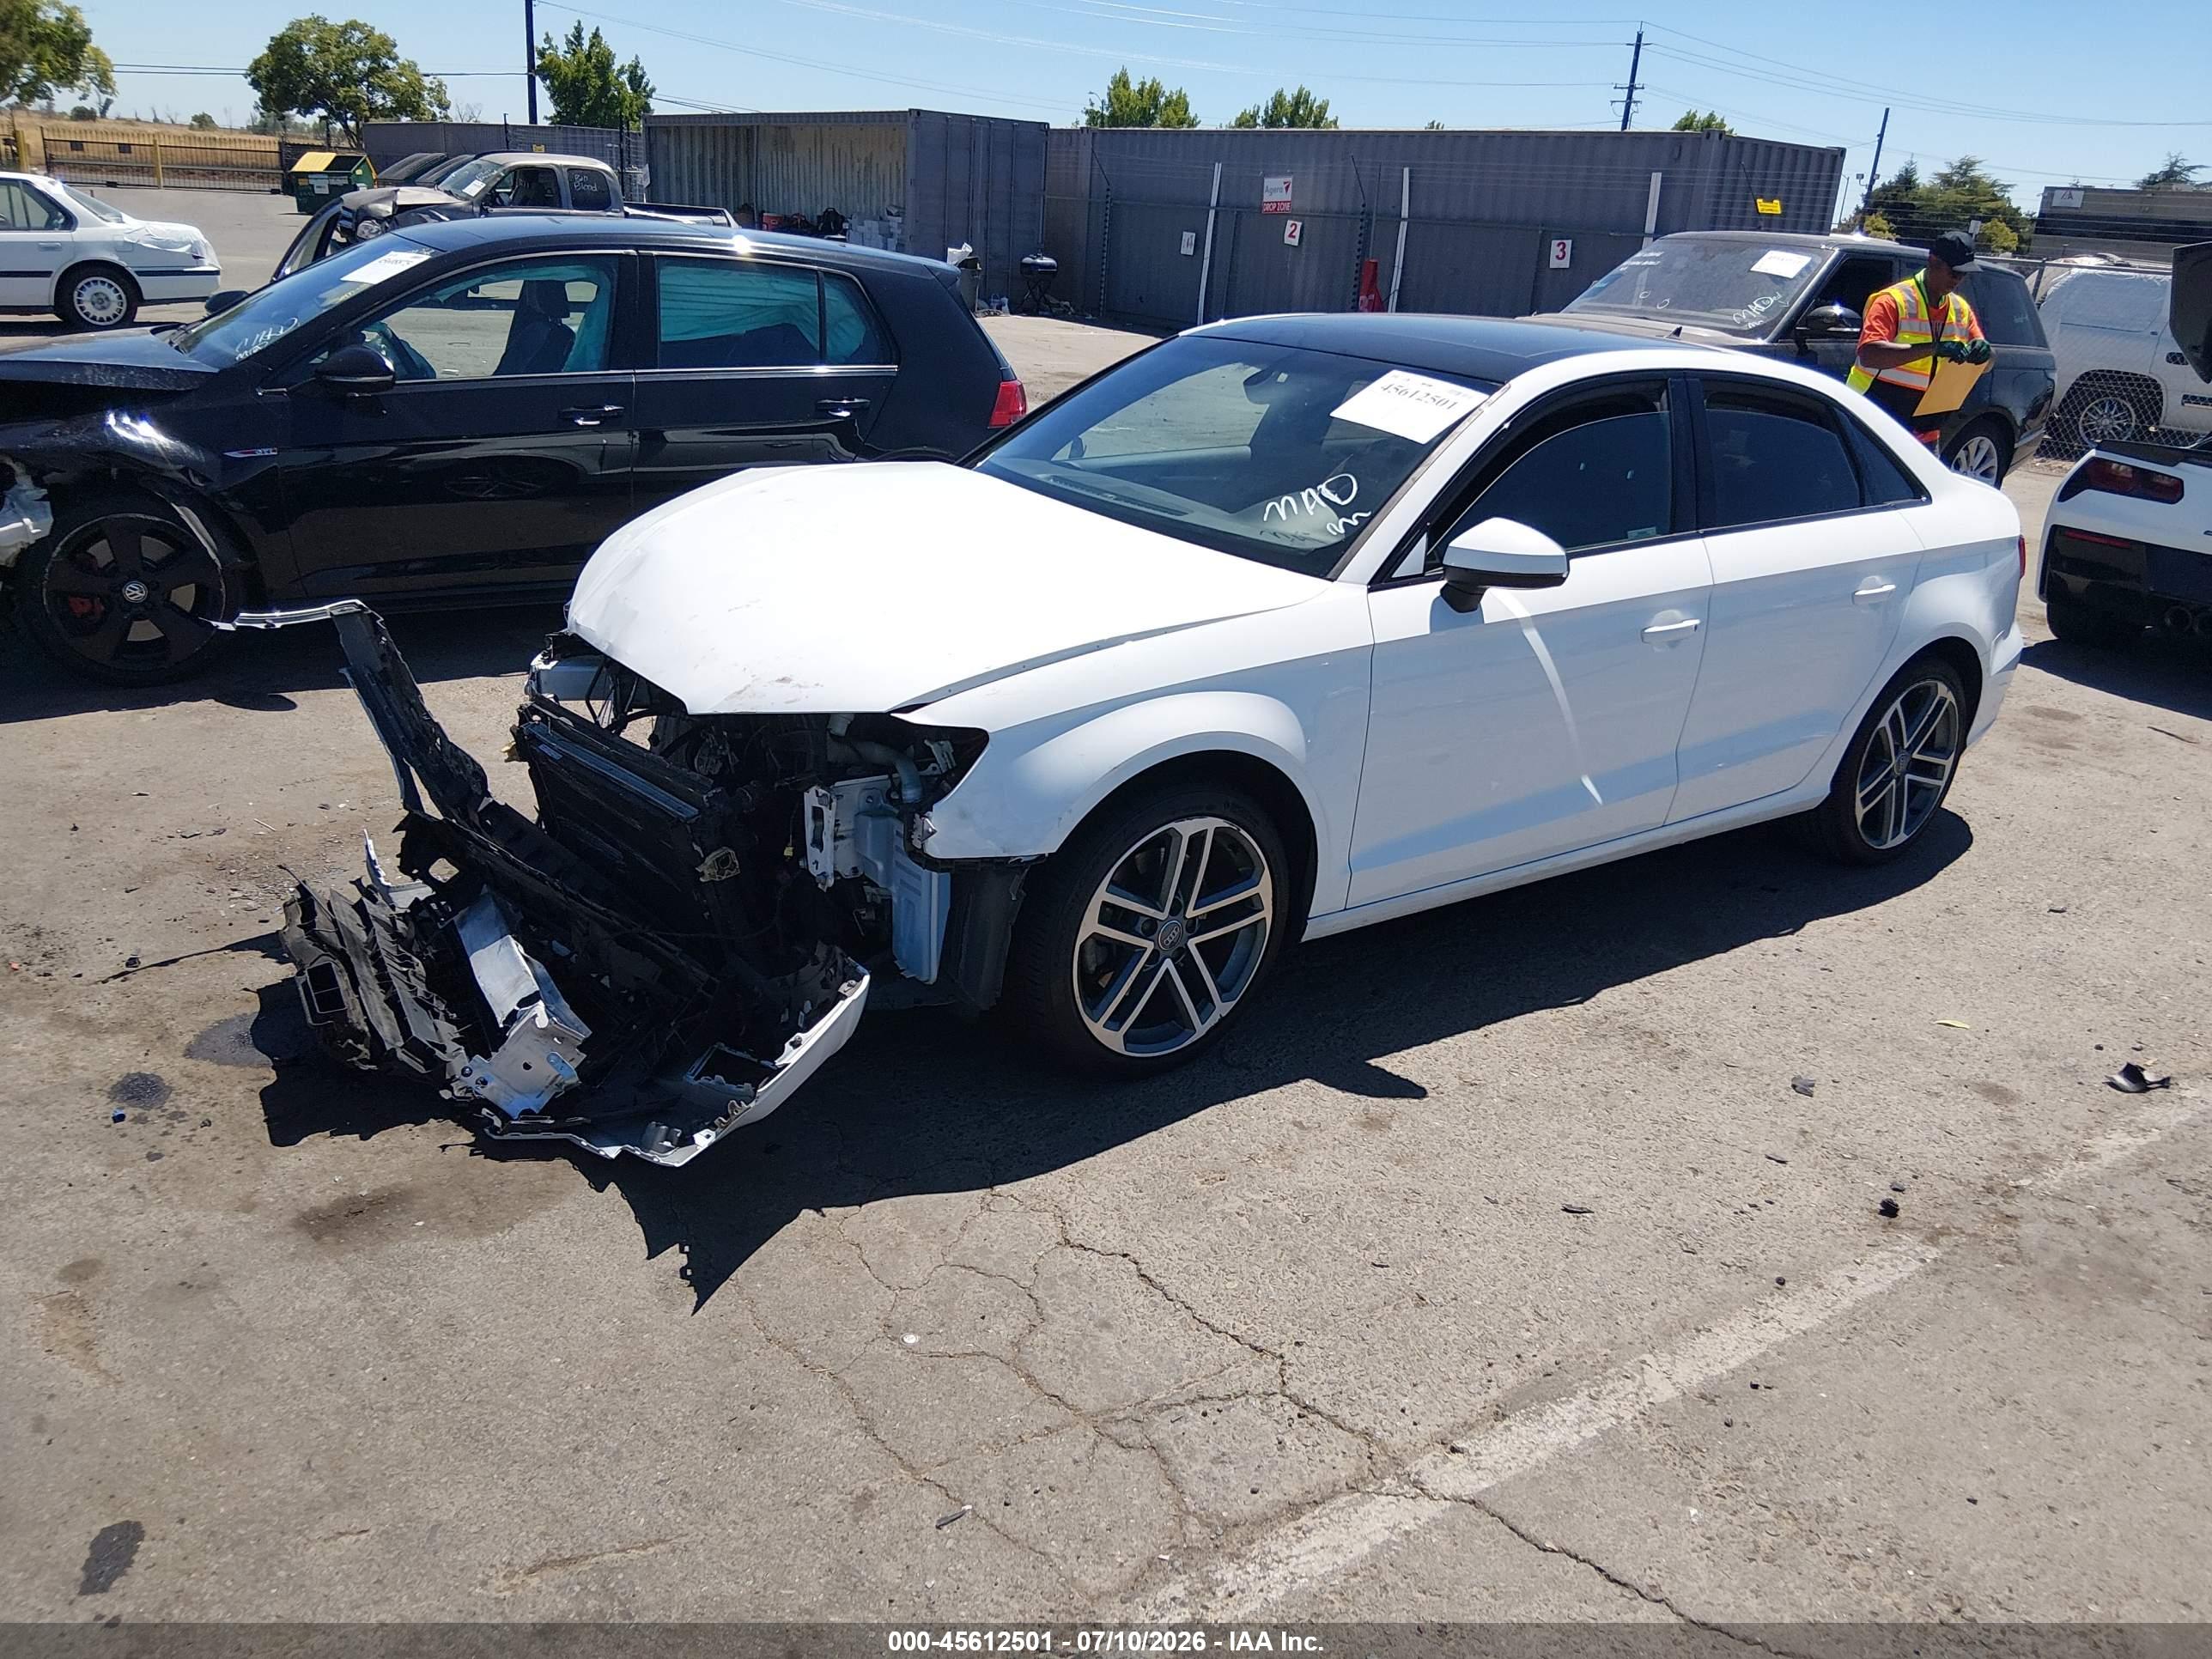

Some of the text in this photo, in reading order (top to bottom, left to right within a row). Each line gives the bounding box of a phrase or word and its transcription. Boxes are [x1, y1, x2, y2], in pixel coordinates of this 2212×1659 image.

[574, 182, 599, 192] Blood
[1263, 202, 1291, 212] DROP ZONE
[1287, 222, 1297, 240] 2
[1555, 241, 1567, 261] 3
[1380, 383, 1459, 410] 45612501
[1263, 473, 1358, 522] MAD
